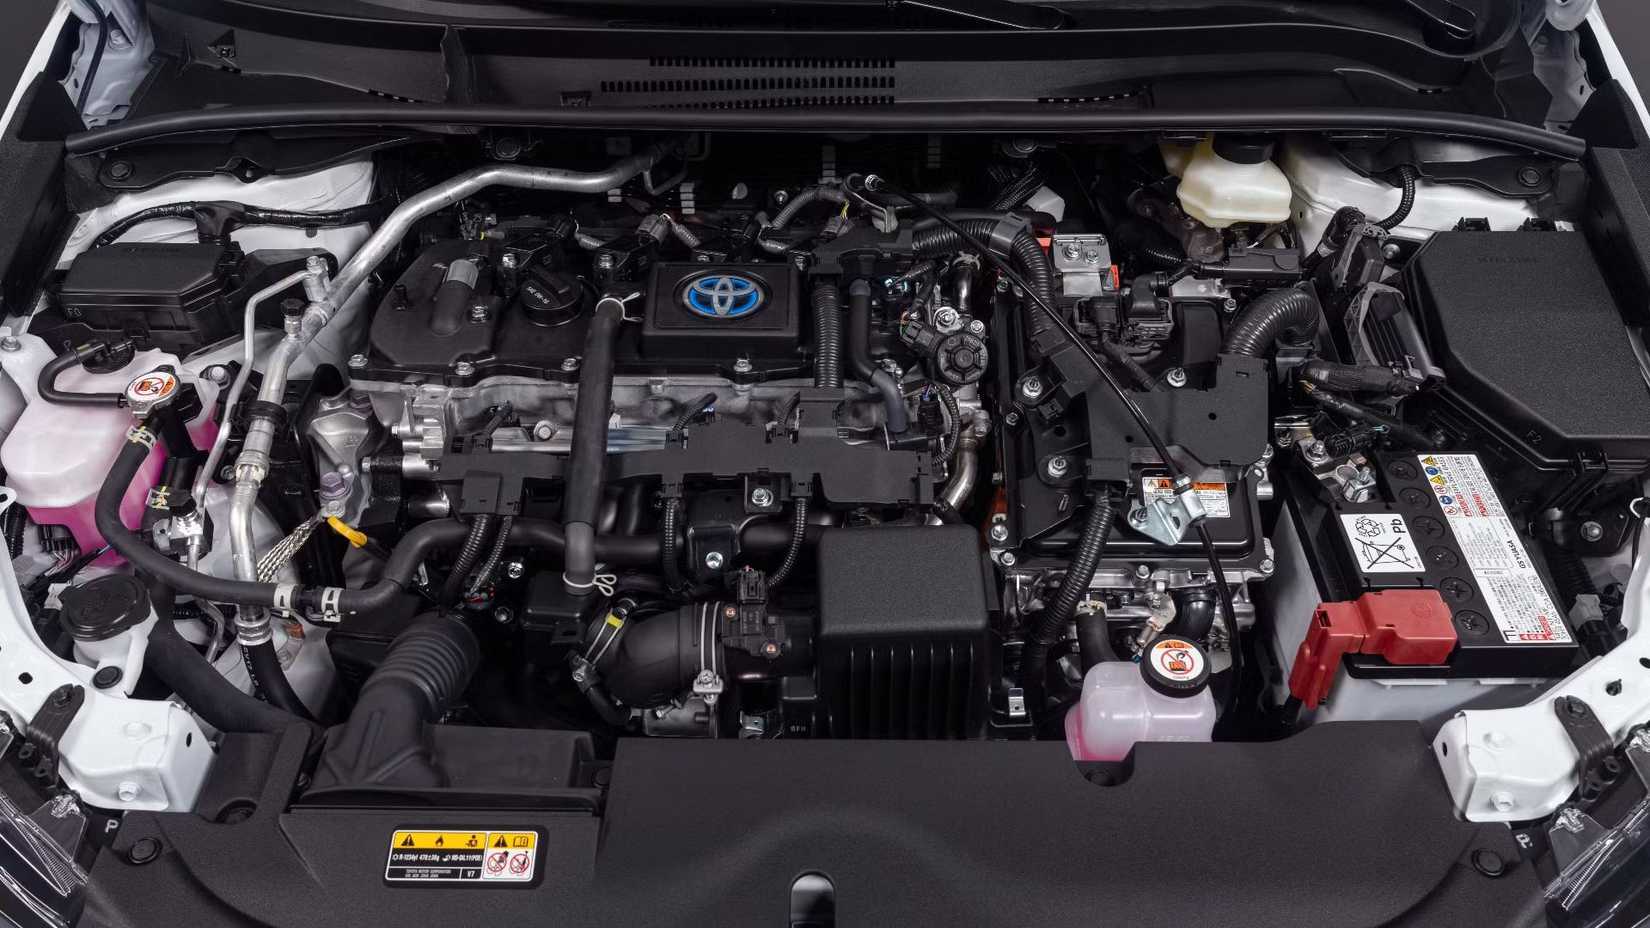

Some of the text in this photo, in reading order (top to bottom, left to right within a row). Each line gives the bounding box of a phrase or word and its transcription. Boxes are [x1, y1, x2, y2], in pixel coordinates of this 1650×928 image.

[1390, 518, 1406, 533] Pb
[1506, 540, 1521, 560] YUASA
[104, 819, 118, 832] P
